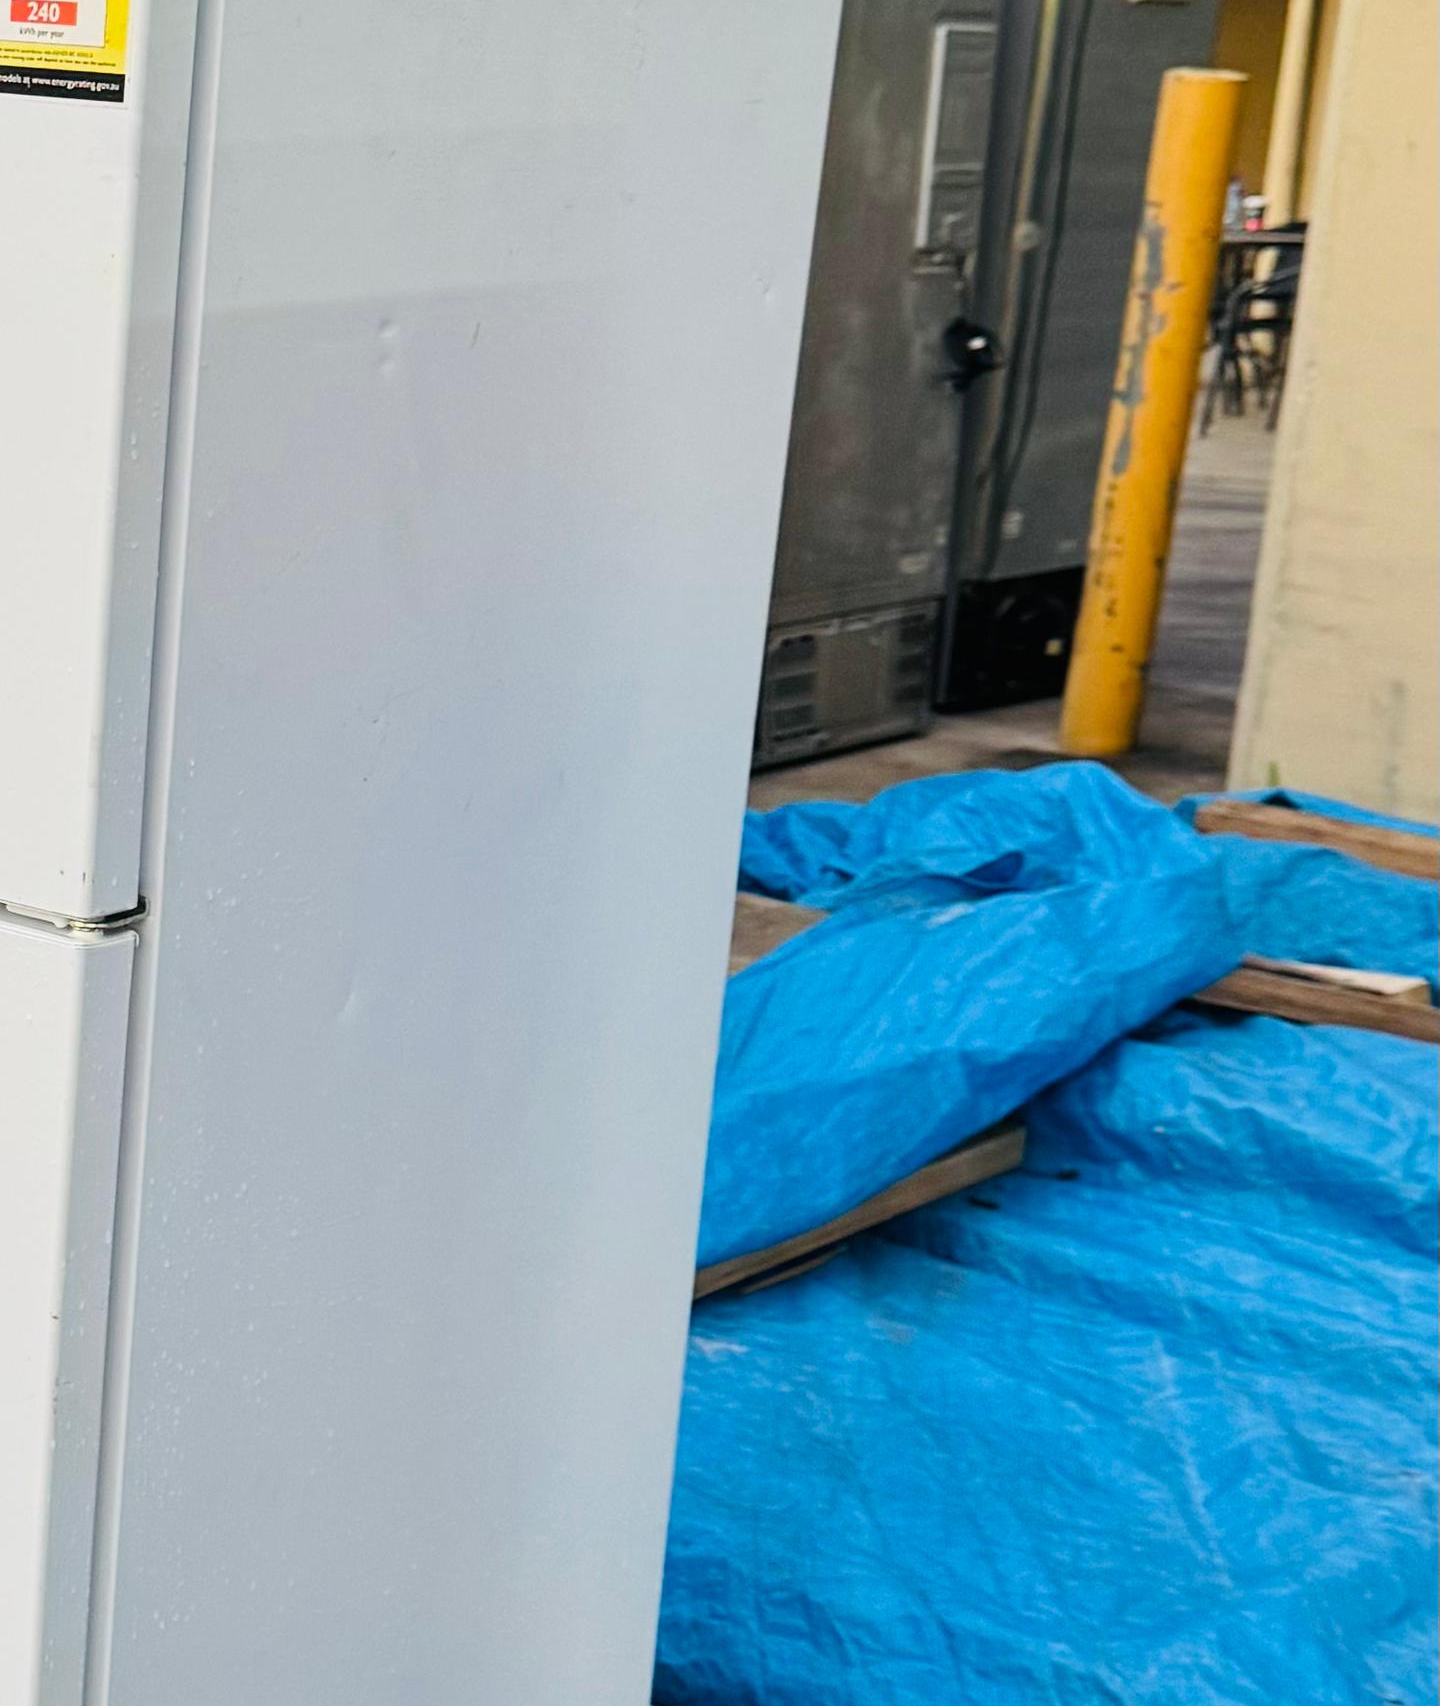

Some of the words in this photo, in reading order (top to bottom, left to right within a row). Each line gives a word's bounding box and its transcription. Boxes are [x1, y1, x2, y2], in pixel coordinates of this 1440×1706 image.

[27, 1, 61, 23] 240
[37, 29, 49, 39] per
[50, 30, 65, 40] year
